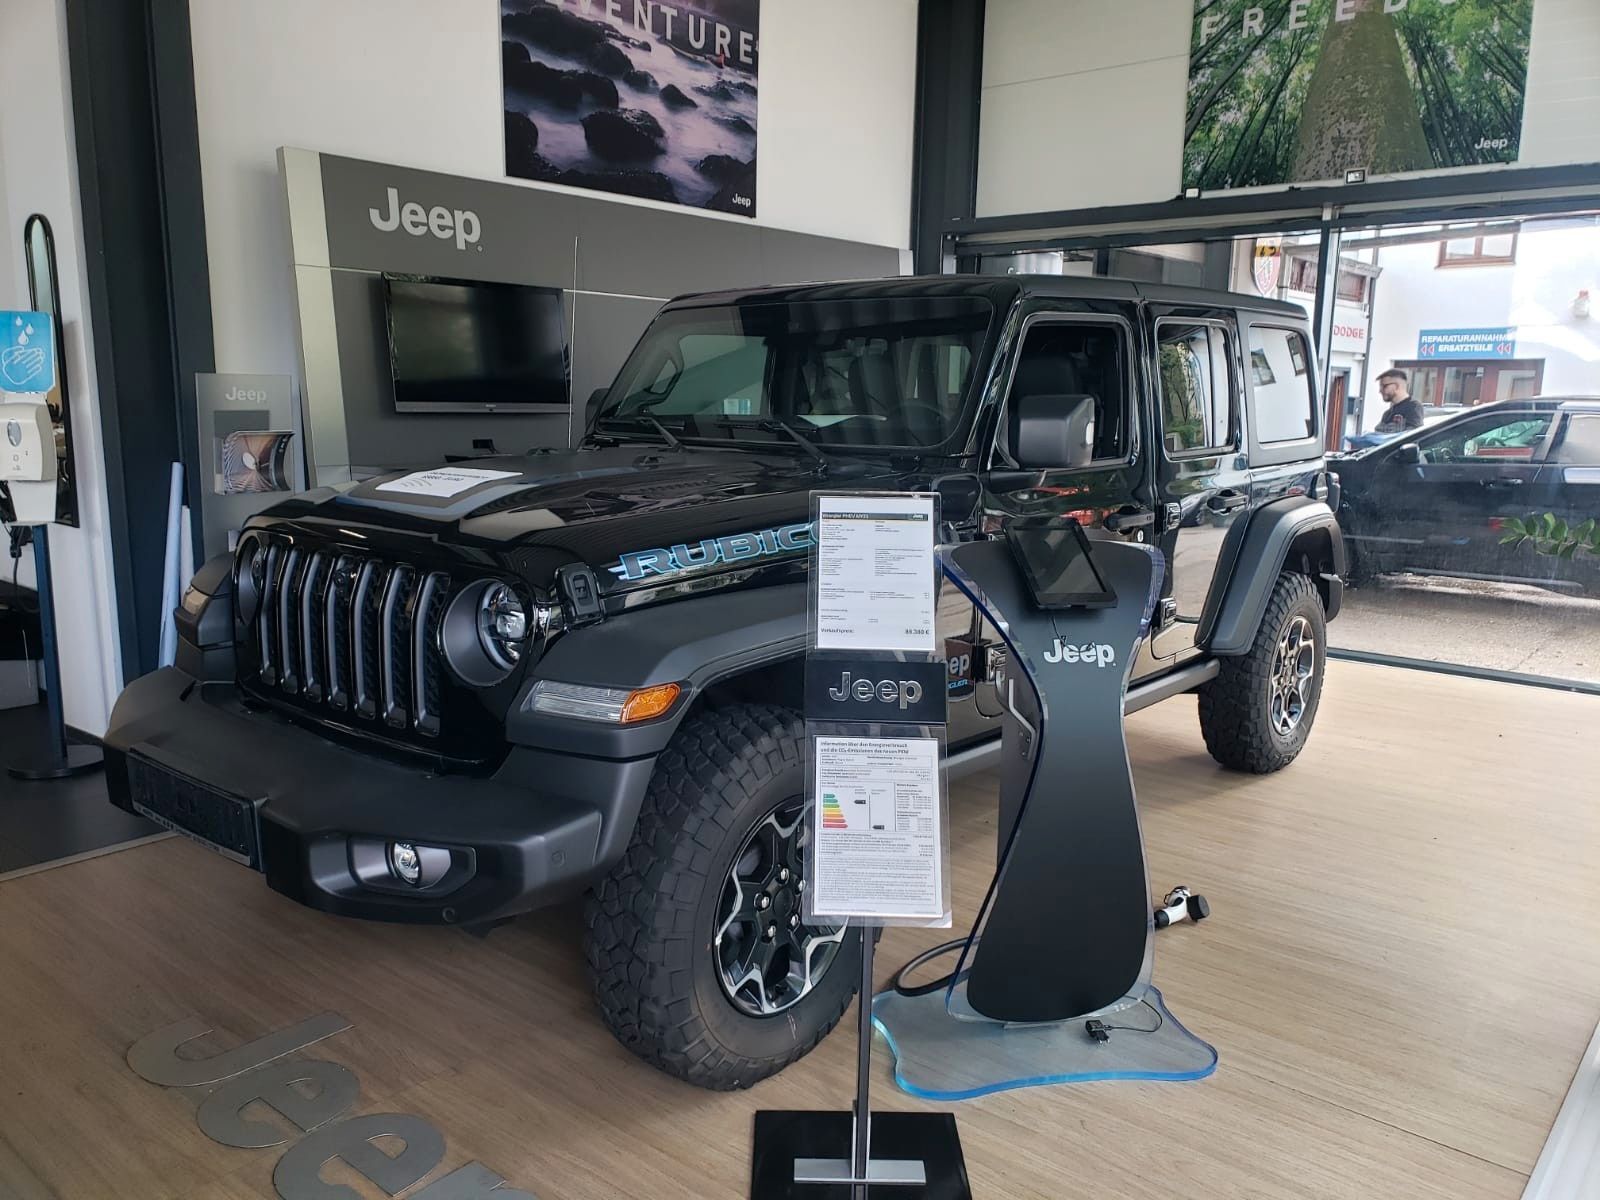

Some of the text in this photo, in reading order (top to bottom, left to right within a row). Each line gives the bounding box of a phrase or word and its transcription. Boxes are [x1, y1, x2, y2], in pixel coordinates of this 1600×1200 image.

[1474, 137, 1508, 150] Jeep
[732, 193, 751, 208] Jeep
[369, 187, 481, 251] Jeep
[1333, 325, 1364, 339] DODGE
[1438, 343, 1494, 352] ERSATZTEILE
[225, 386, 267, 404] Jeep
[620, 519, 819, 579] RUBIC
[1044, 639, 1115, 667] Jeep
[829, 671, 923, 709] Jeep
